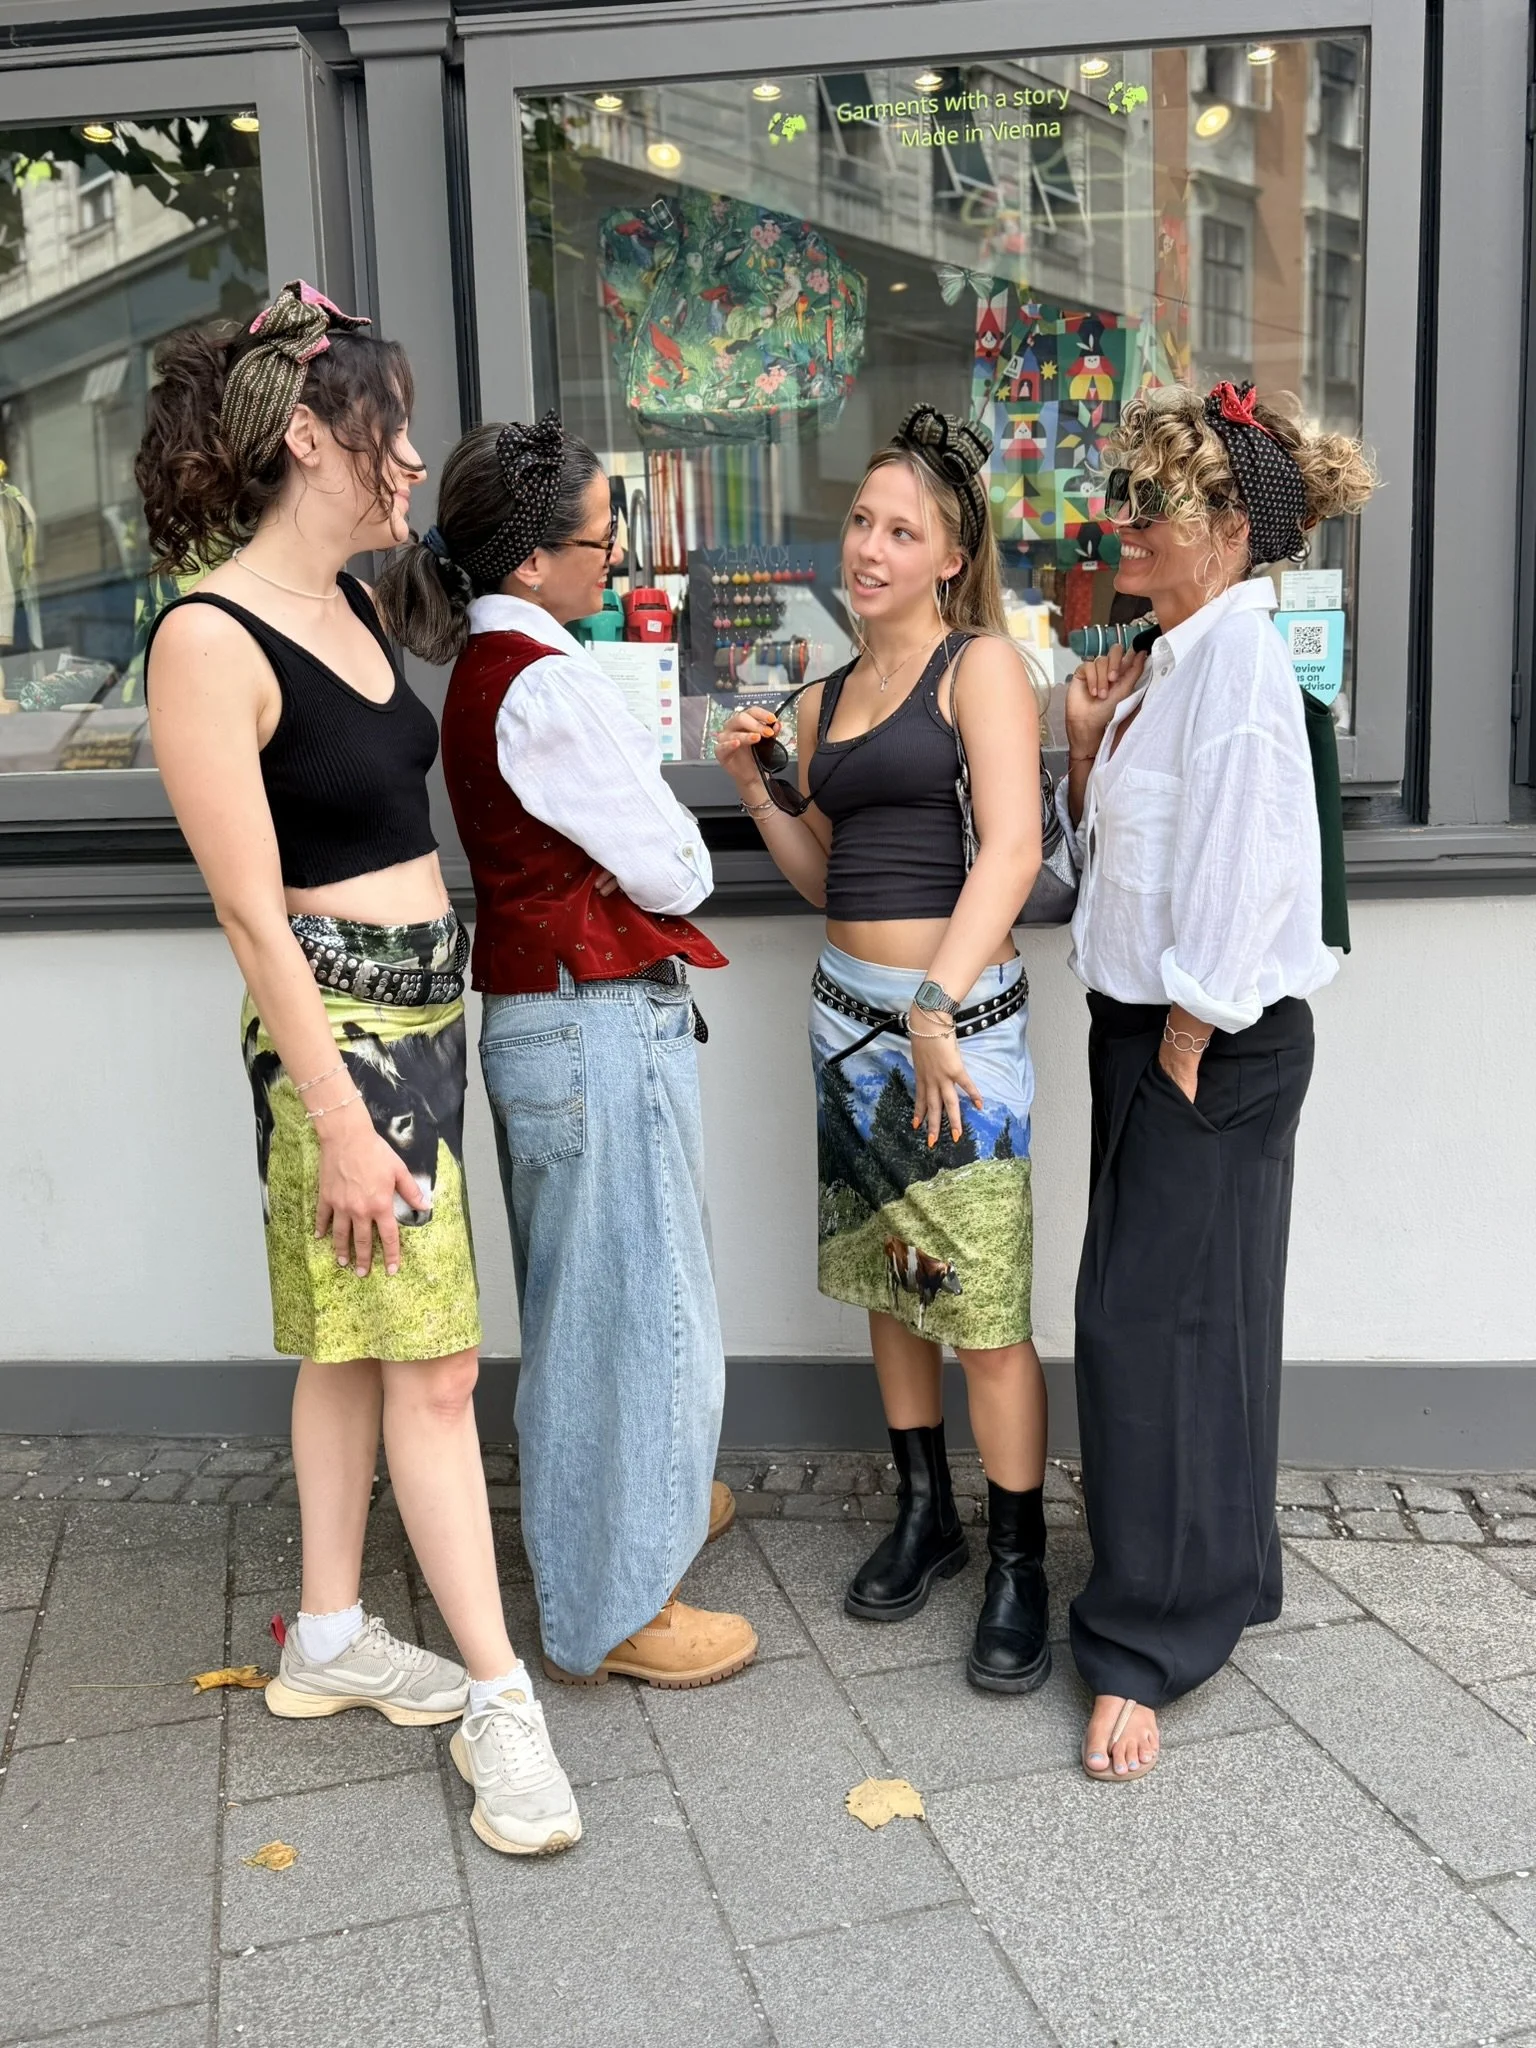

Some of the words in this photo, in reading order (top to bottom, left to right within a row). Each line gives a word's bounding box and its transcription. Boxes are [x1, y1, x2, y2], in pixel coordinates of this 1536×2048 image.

[836, 97, 938, 122] Garments
[944, 89, 988, 112] with
[994, 92, 1007, 108] a
[1012, 87, 1070, 111] story
[901, 125, 959, 148] Made
[964, 124, 984, 144] in
[989, 120, 1061, 142] Vienna
[1306, 674, 1320, 682] on
